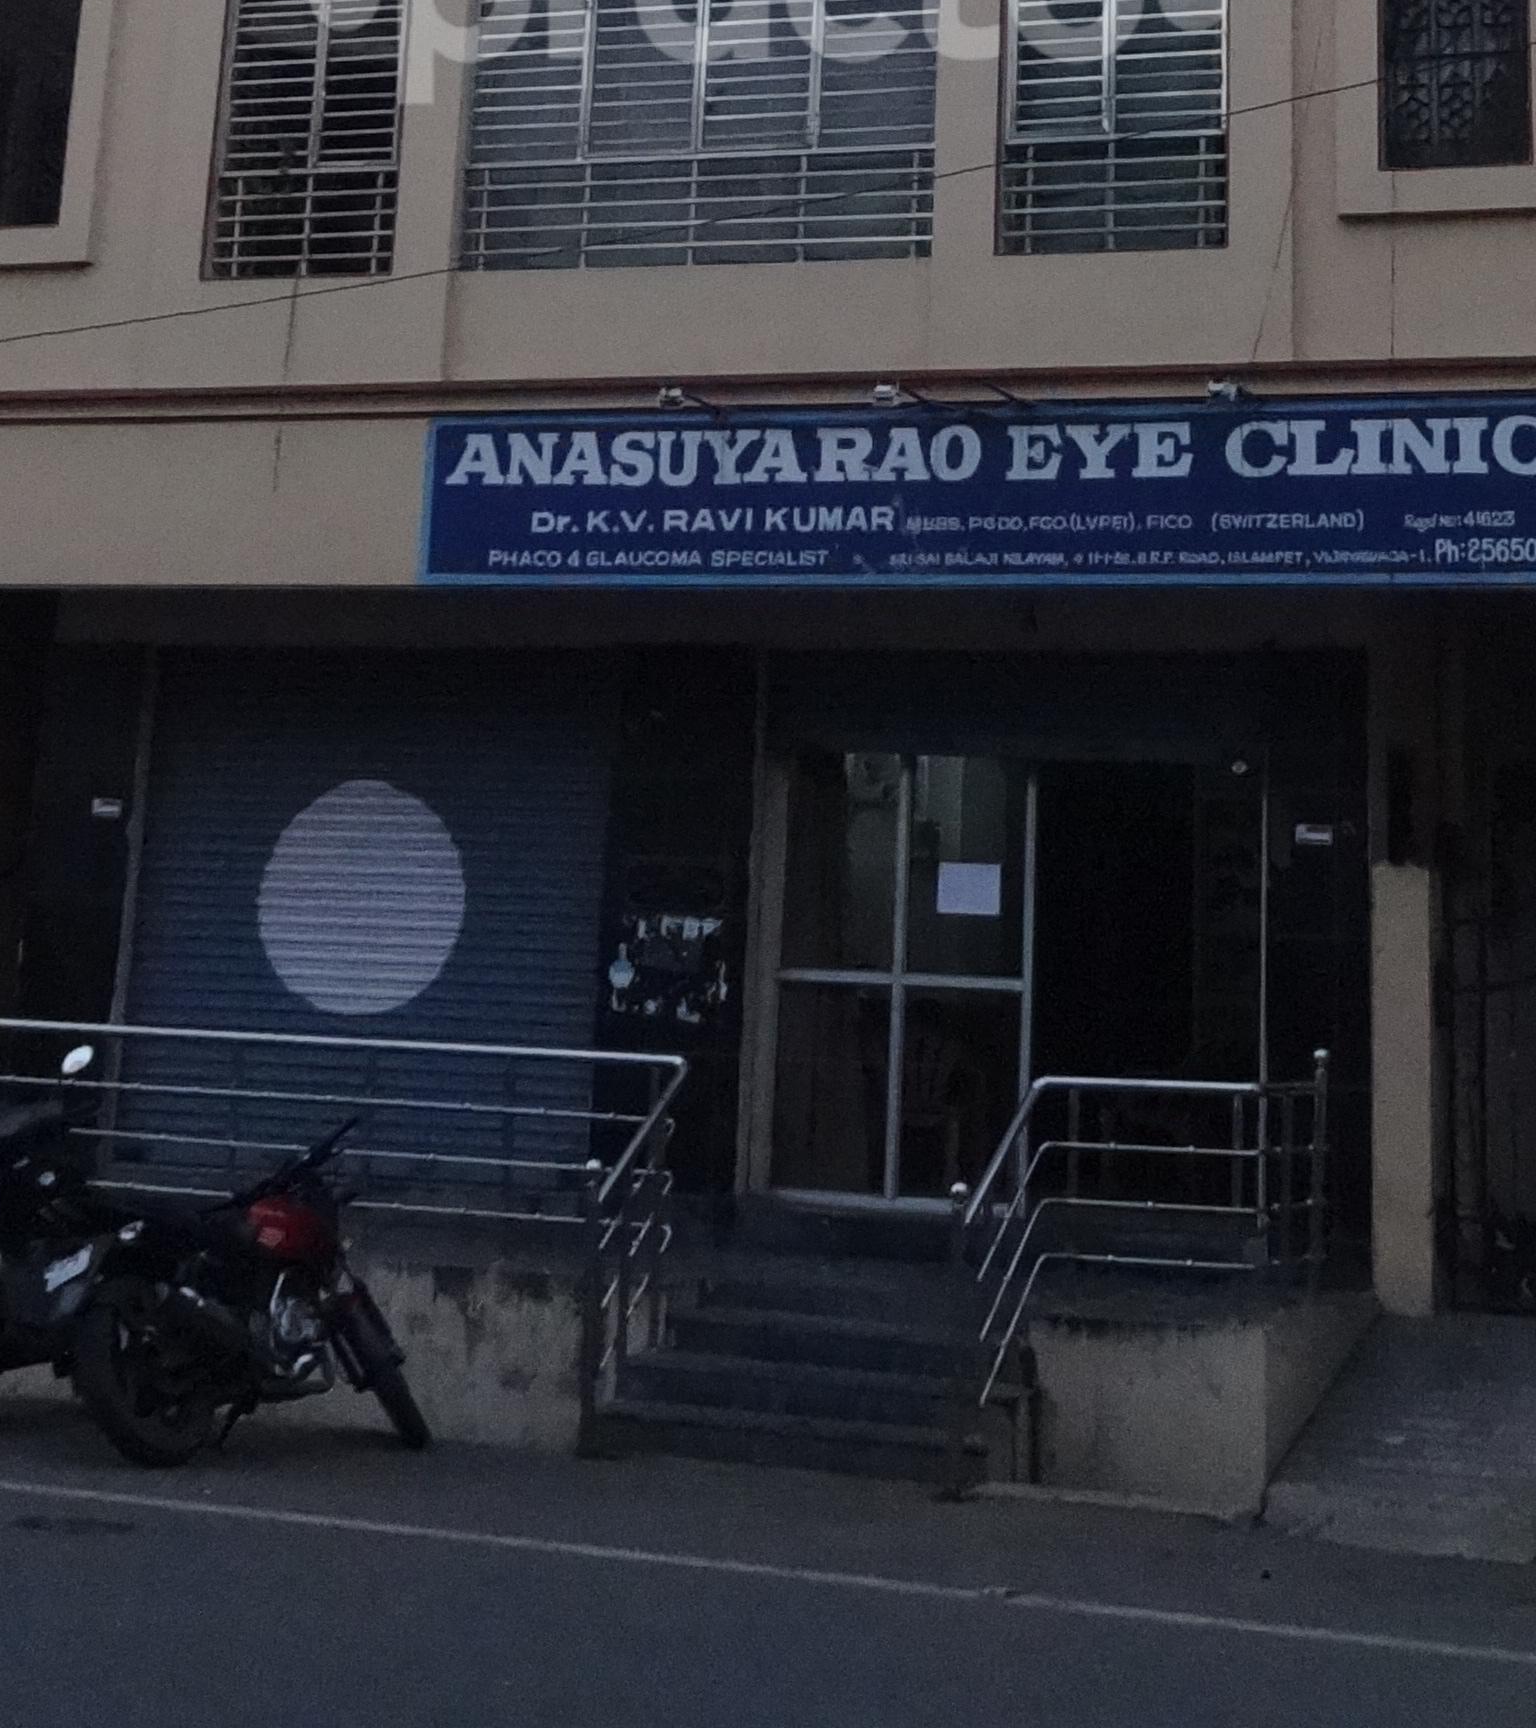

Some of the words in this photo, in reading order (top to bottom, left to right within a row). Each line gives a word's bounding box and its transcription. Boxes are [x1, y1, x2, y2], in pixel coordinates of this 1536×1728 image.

[1005, 420, 1193, 480] EYE
[663, 506, 754, 532] RAVI
[763, 505, 895, 532] KUMAR
[488, 550, 562, 567] PHACO
[586, 549, 703, 567] GLAUCOMA
[710, 549, 829, 567] SPECIALIST
